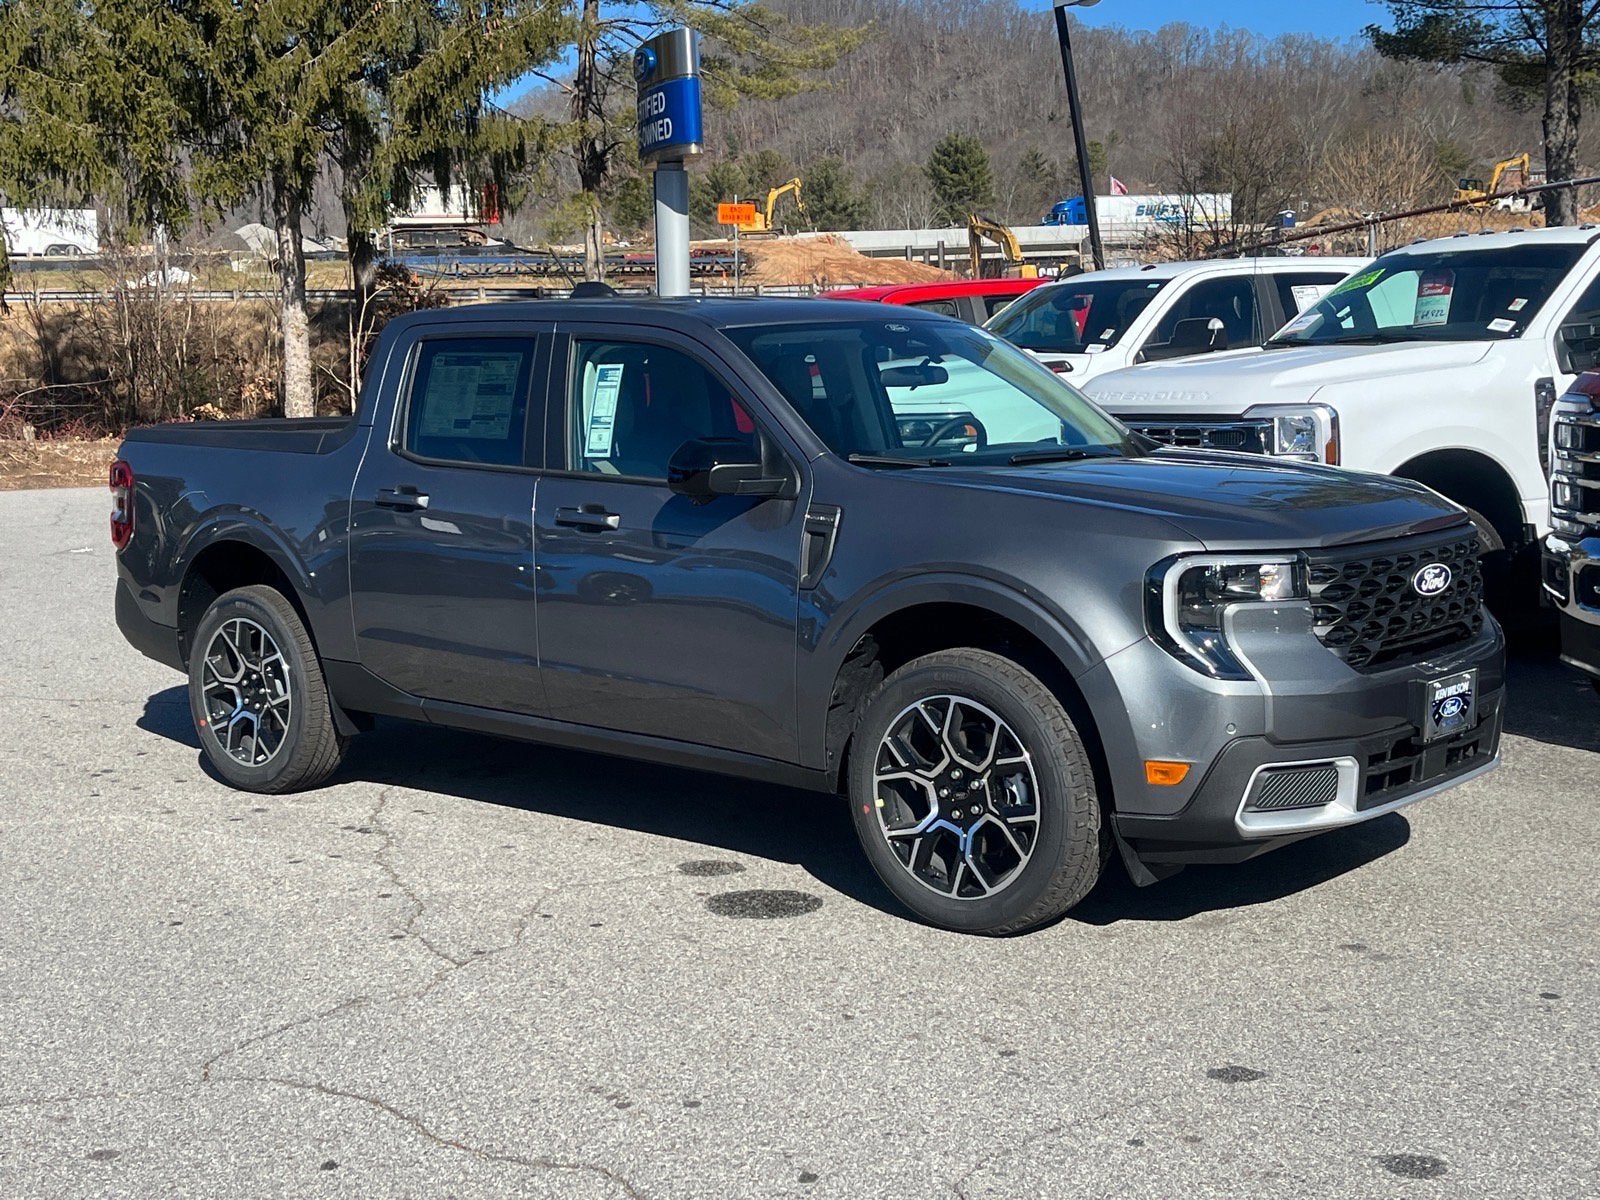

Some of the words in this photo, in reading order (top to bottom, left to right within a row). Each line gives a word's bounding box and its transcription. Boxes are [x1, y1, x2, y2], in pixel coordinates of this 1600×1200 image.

[1135, 204, 1180, 217] SWIFT
[1038, 267, 1059, 278] CAT
[1421, 567, 1446, 591] Ford
